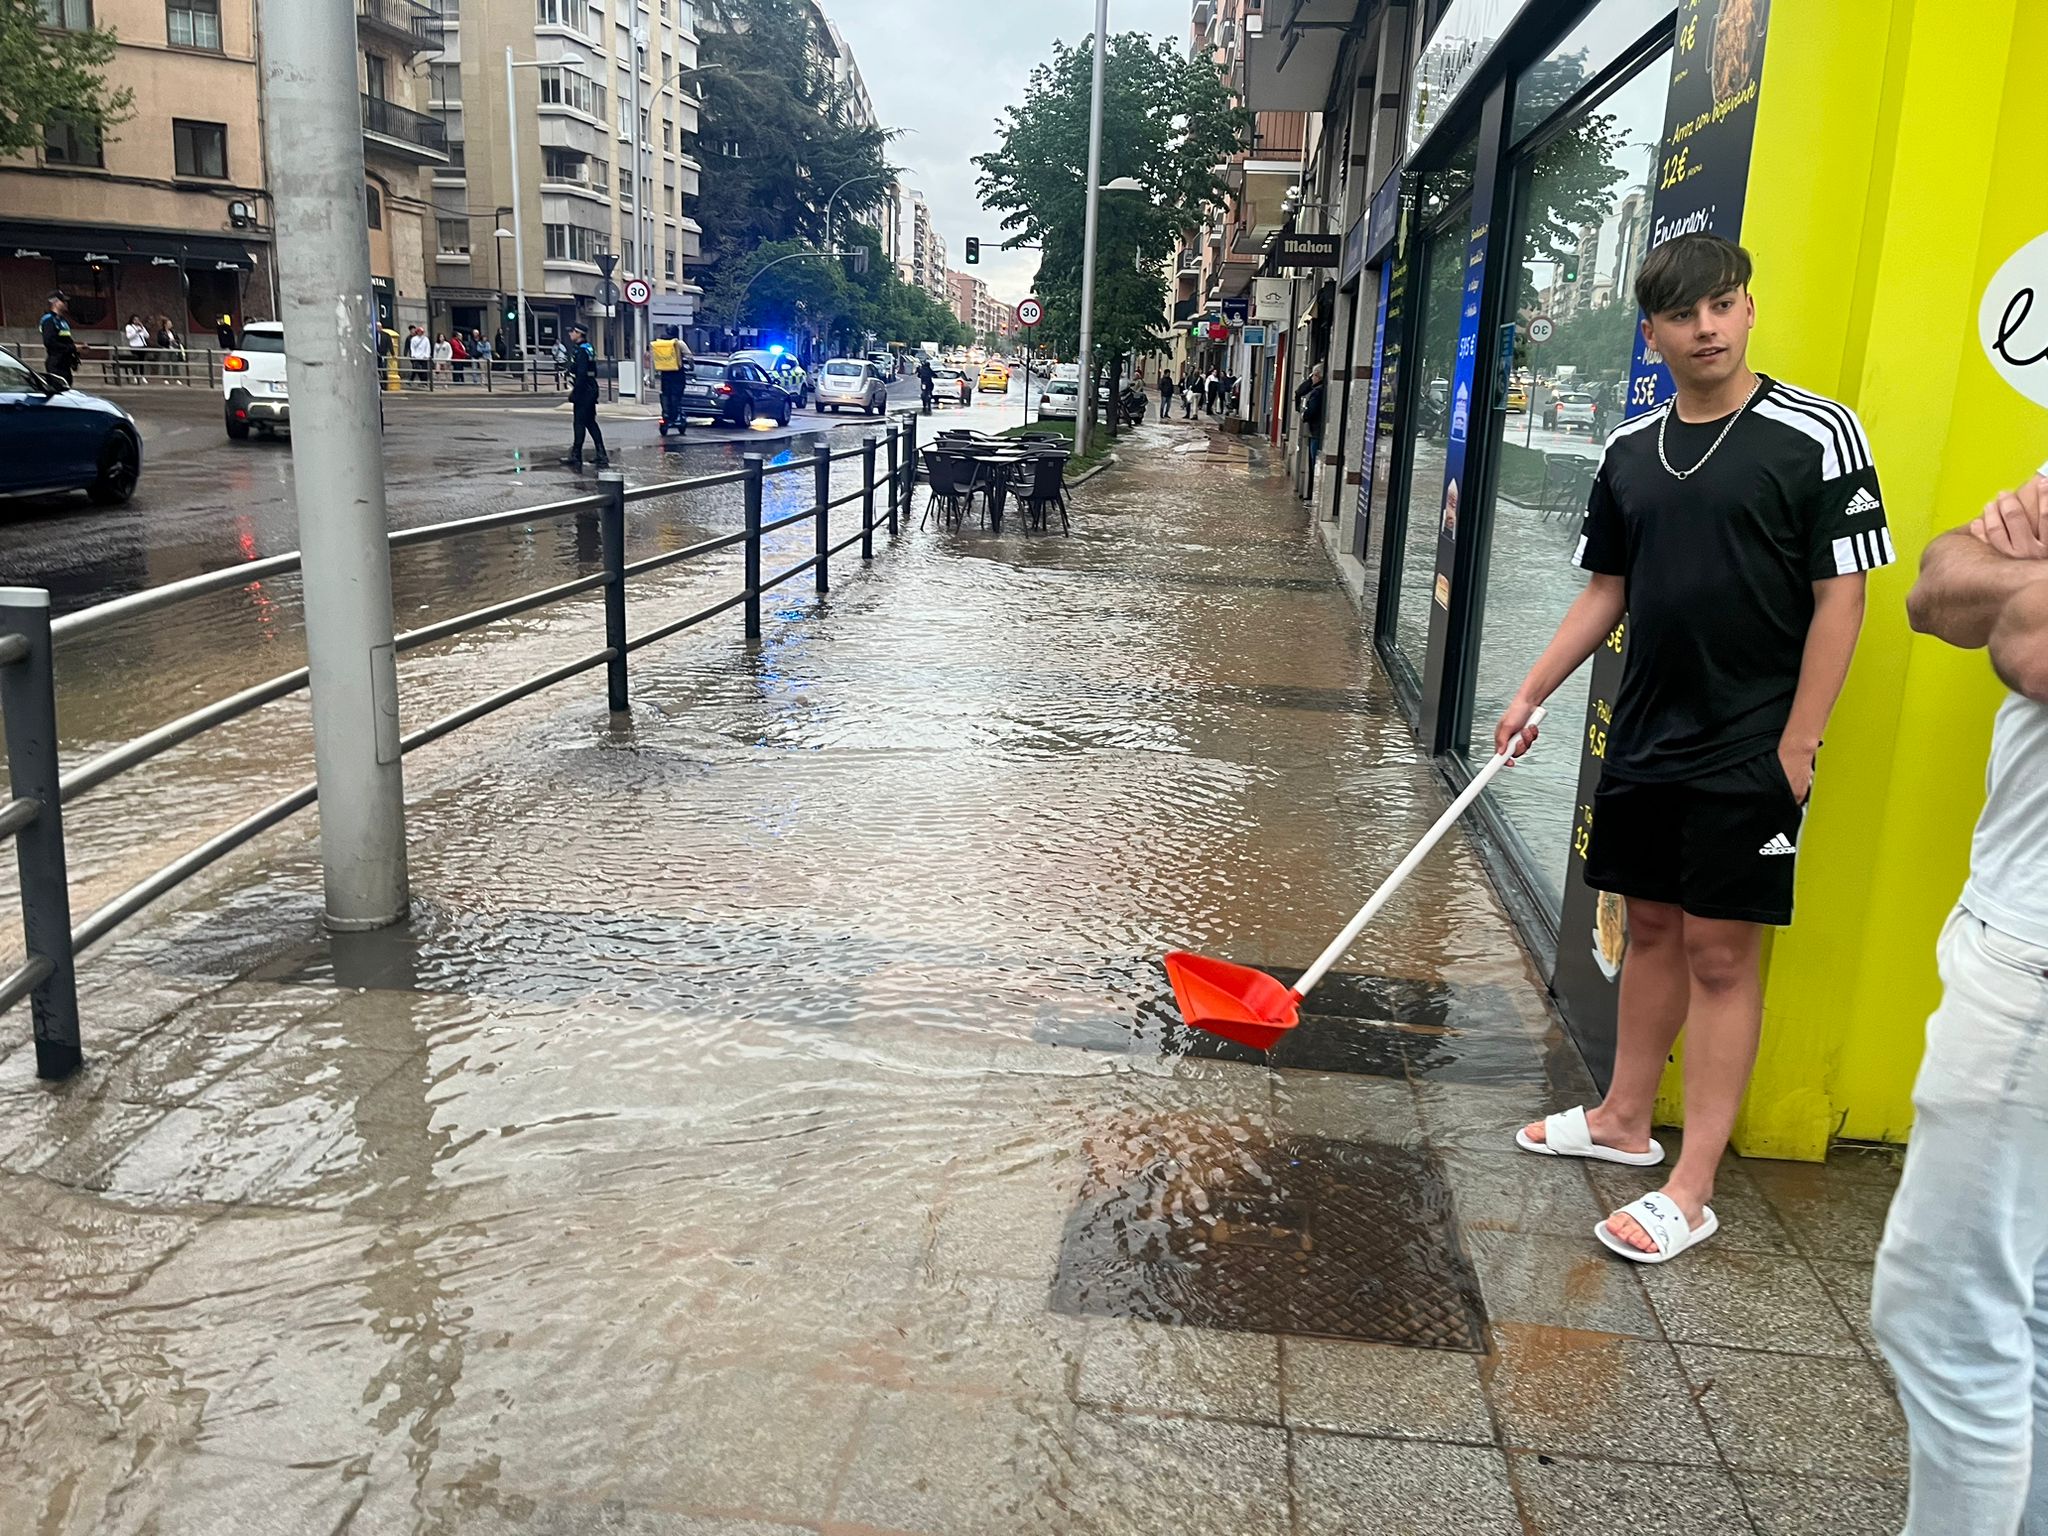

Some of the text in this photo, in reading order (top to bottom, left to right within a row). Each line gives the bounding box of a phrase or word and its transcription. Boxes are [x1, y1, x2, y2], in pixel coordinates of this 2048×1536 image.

[1695, 112, 1711, 132] con
[1284, 240, 1333, 254] Mahou
[630, 287, 645, 298] 30
[1022, 307, 1038, 318] 30
[1631, 373, 1658, 406] 55€
[1845, 500, 1880, 515] adidas
[1758, 846, 1797, 856] adidas
